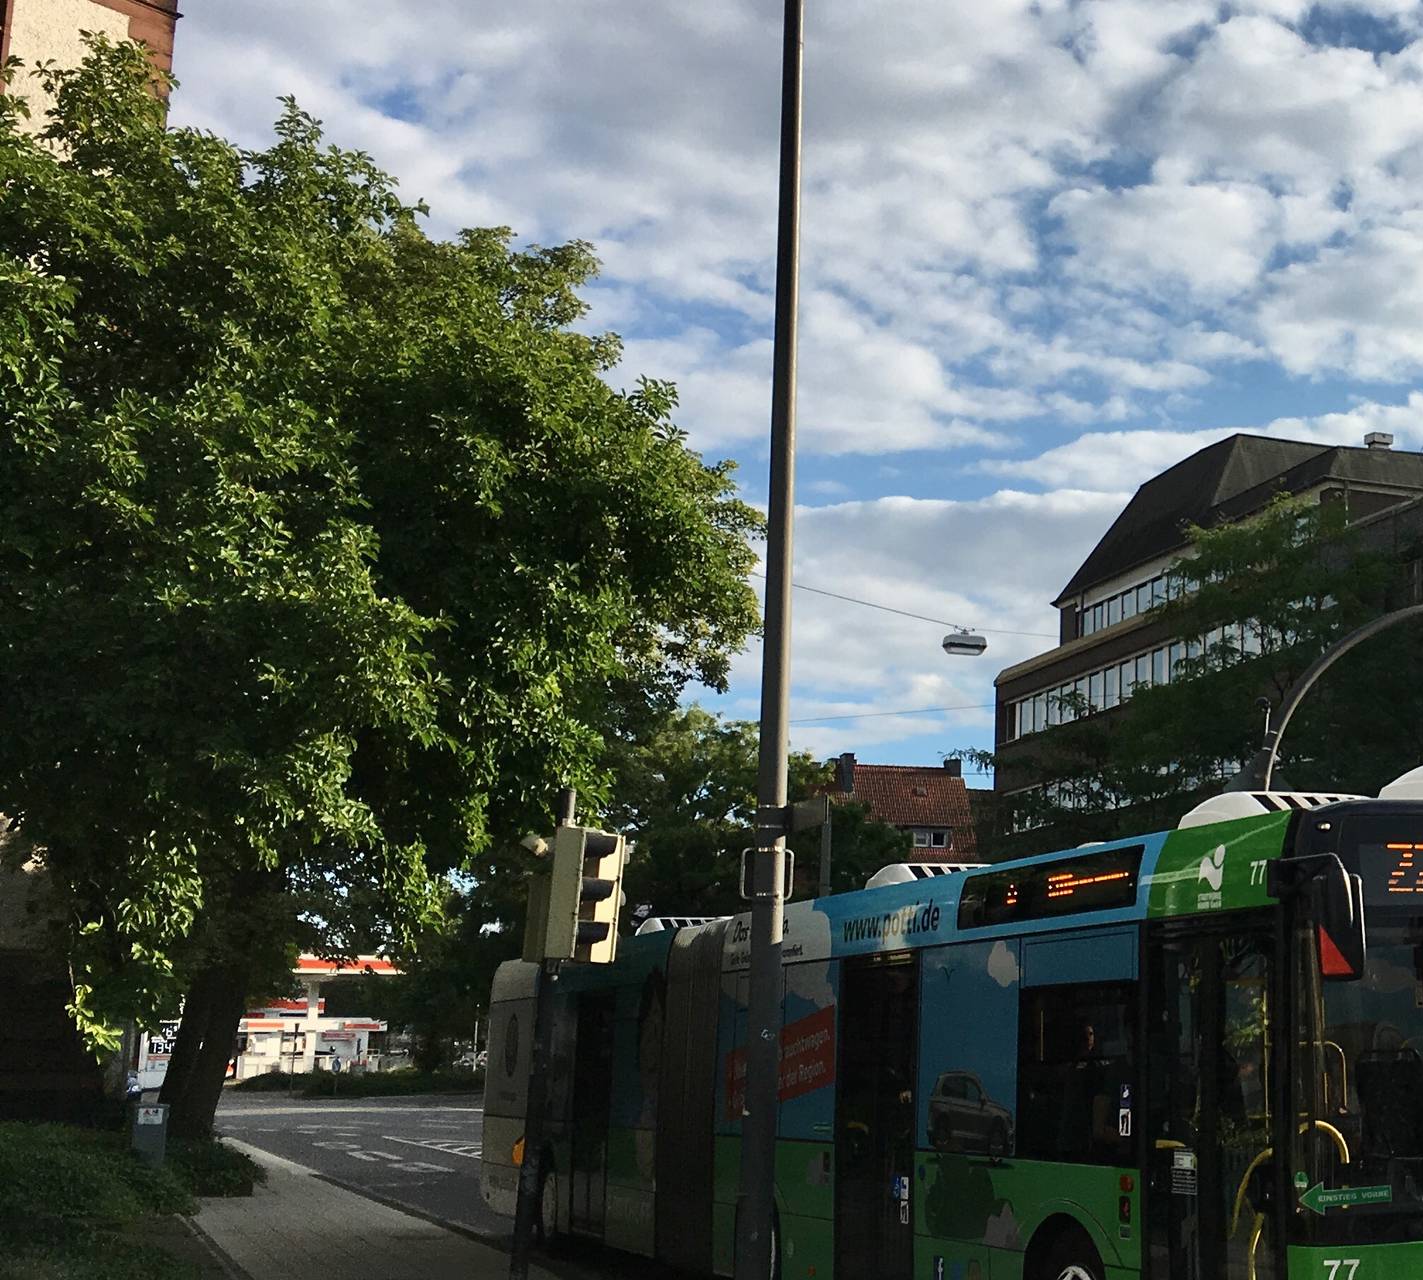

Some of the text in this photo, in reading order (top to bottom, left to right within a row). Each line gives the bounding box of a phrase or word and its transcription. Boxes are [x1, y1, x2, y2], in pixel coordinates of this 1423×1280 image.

[1250, 859, 1267, 886] 77
[843, 898, 940, 945] www.potti.de
[1323, 1258, 1361, 1280] 77
